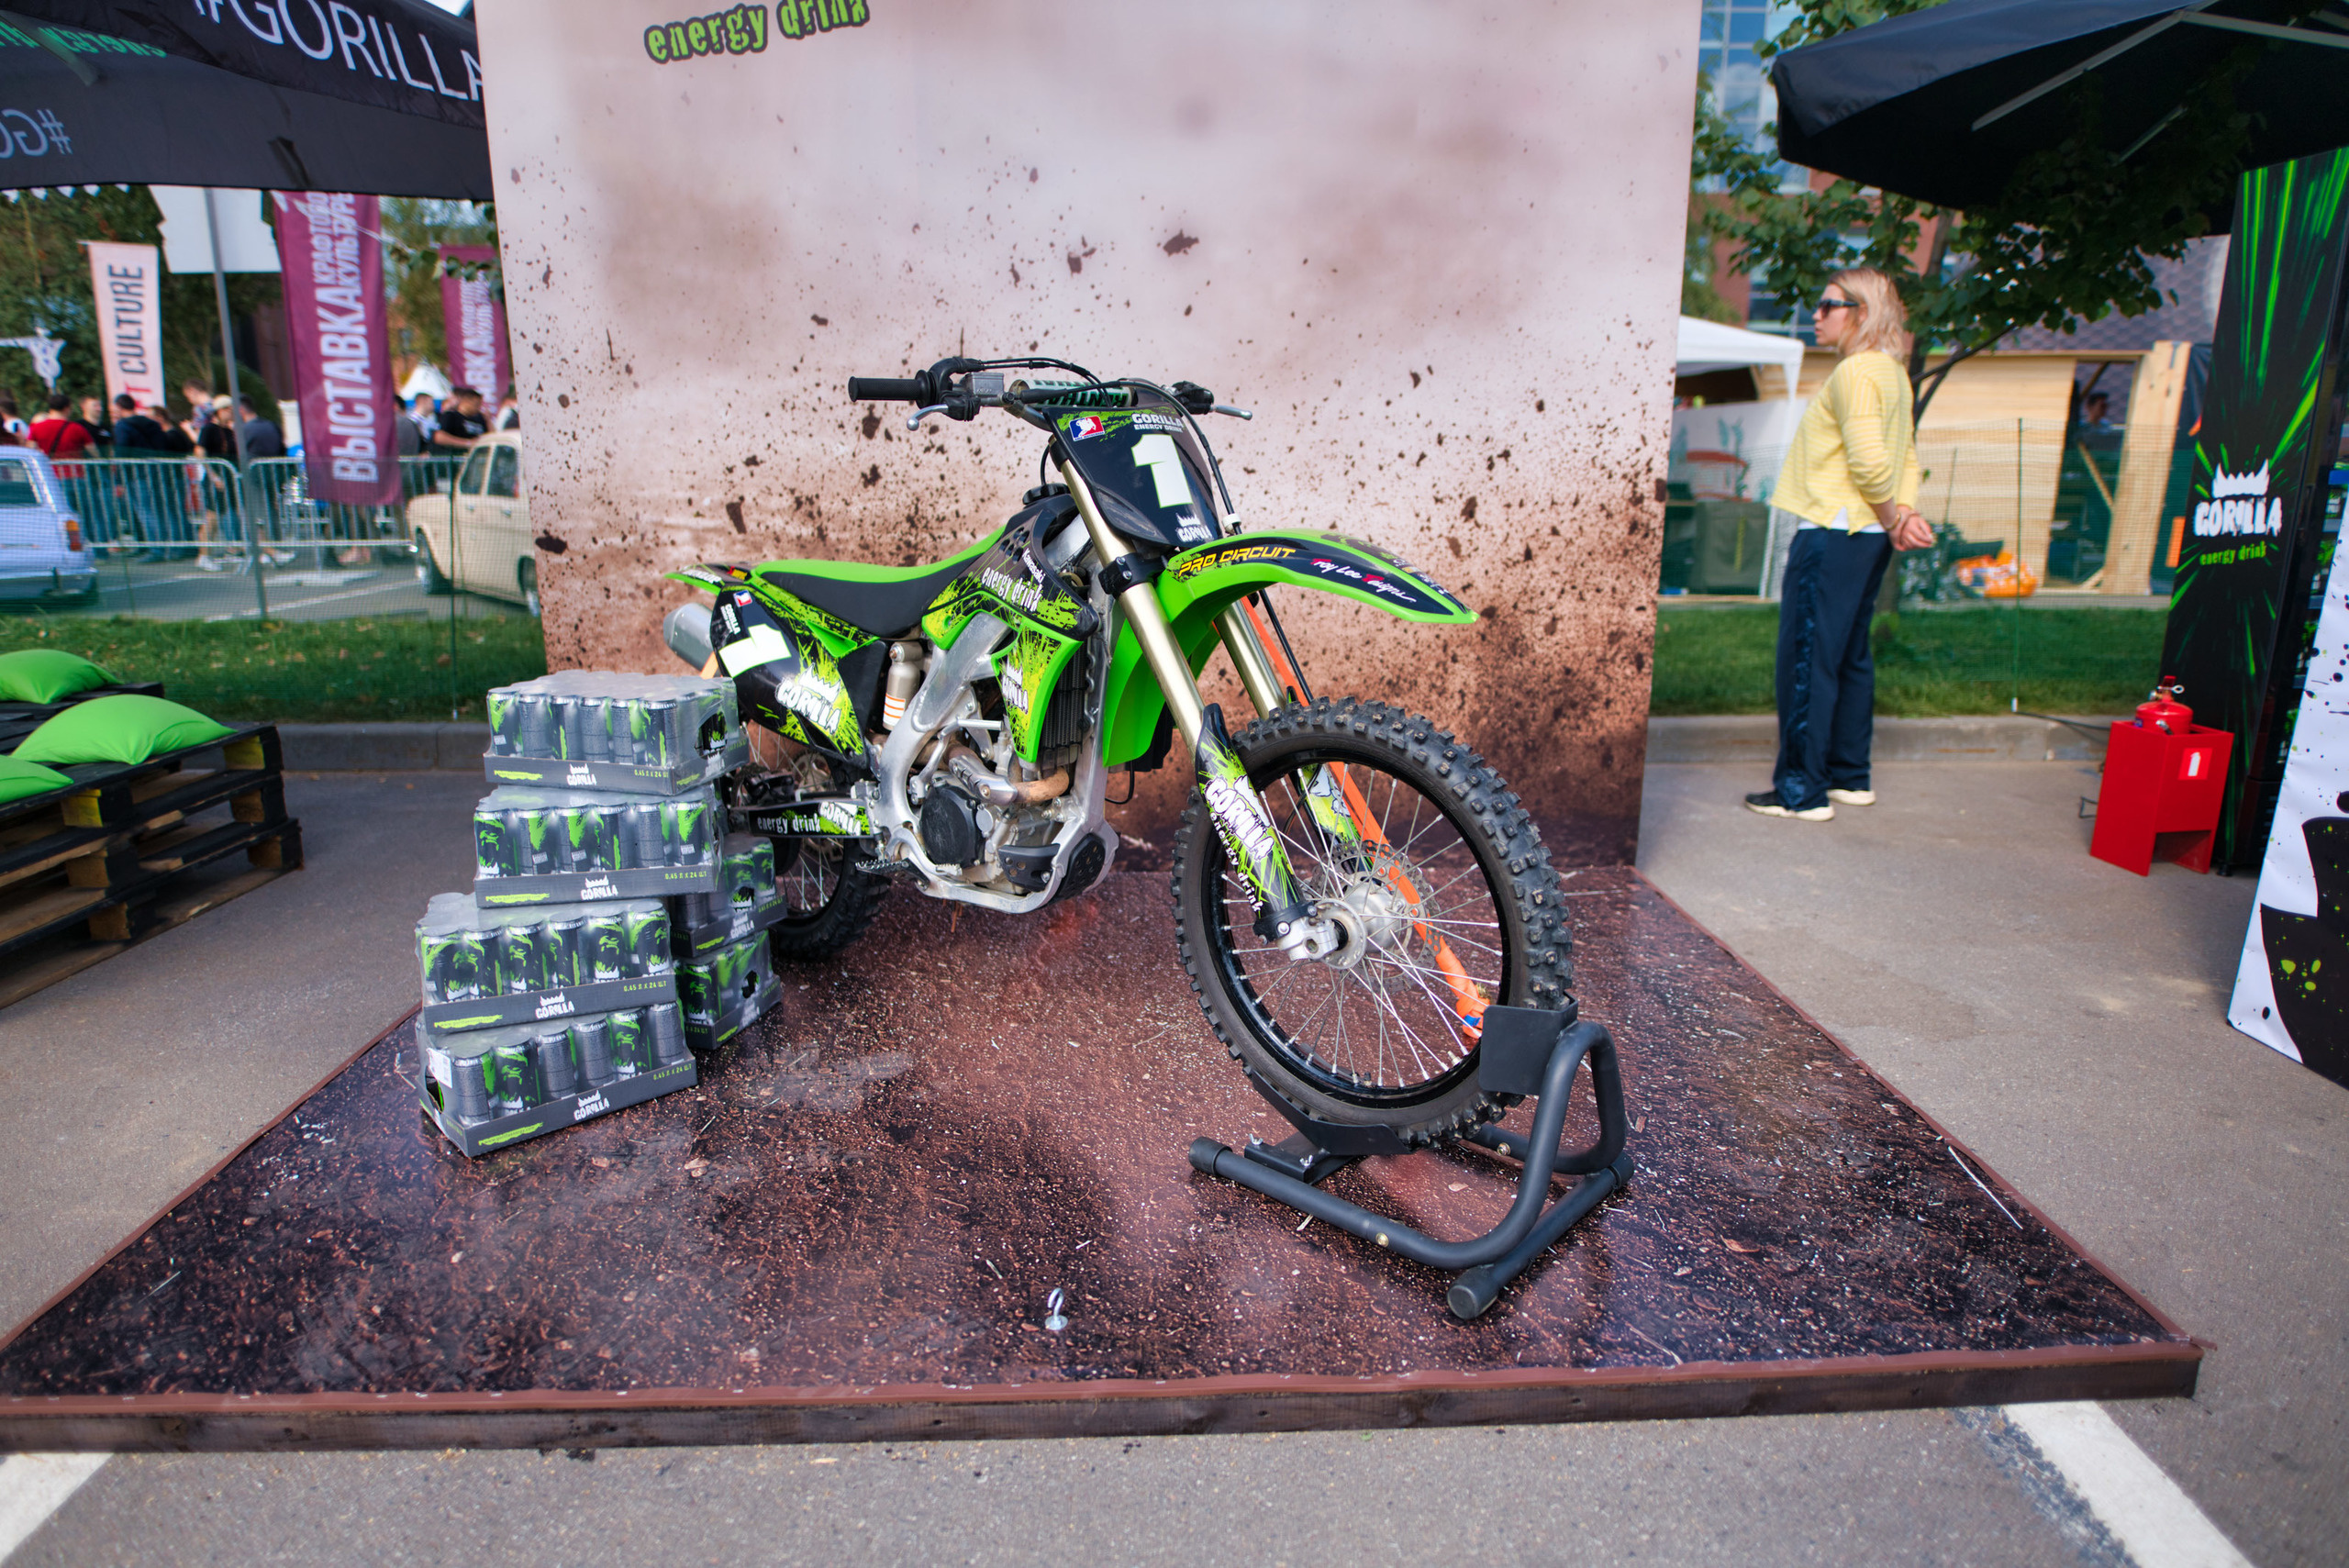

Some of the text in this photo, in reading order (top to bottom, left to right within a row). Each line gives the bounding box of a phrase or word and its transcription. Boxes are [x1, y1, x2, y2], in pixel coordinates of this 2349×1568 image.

[644, 4, 767, 63] energy
[108, 264, 147, 374] CULTURE
[316, 286, 379, 484] ВЫСТАВКА
[1131, 413, 1185, 428] GORILLA
[1134, 423, 1185, 434] ENERGY DRINK
[1131, 434, 1193, 508] 1
[1175, 526, 1214, 543] GORILLA
[2193, 496, 2283, 538] GORILLA
[1022, 548, 1046, 584] Kawasaki
[1178, 546, 1297, 577] PRO CIRCUIT
[2199, 540, 2267, 566] energy drink
[982, 567, 1043, 612] energy drink
[1336, 565, 1363, 579] Lee
[775, 677, 842, 736] GORILLA
[1001, 673, 1030, 715] GORILLA
[566, 773, 597, 786] GORILLA
[757, 813, 821, 835] energy drink
[819, 801, 862, 836] GORILLA
[1204, 775, 1275, 862] GORILLA
[1209, 812, 1264, 913] energy drink
[581, 884, 618, 901] GORILLA
[535, 1000, 575, 1019] GORILLA
[573, 1097, 611, 1121] GORILLA
